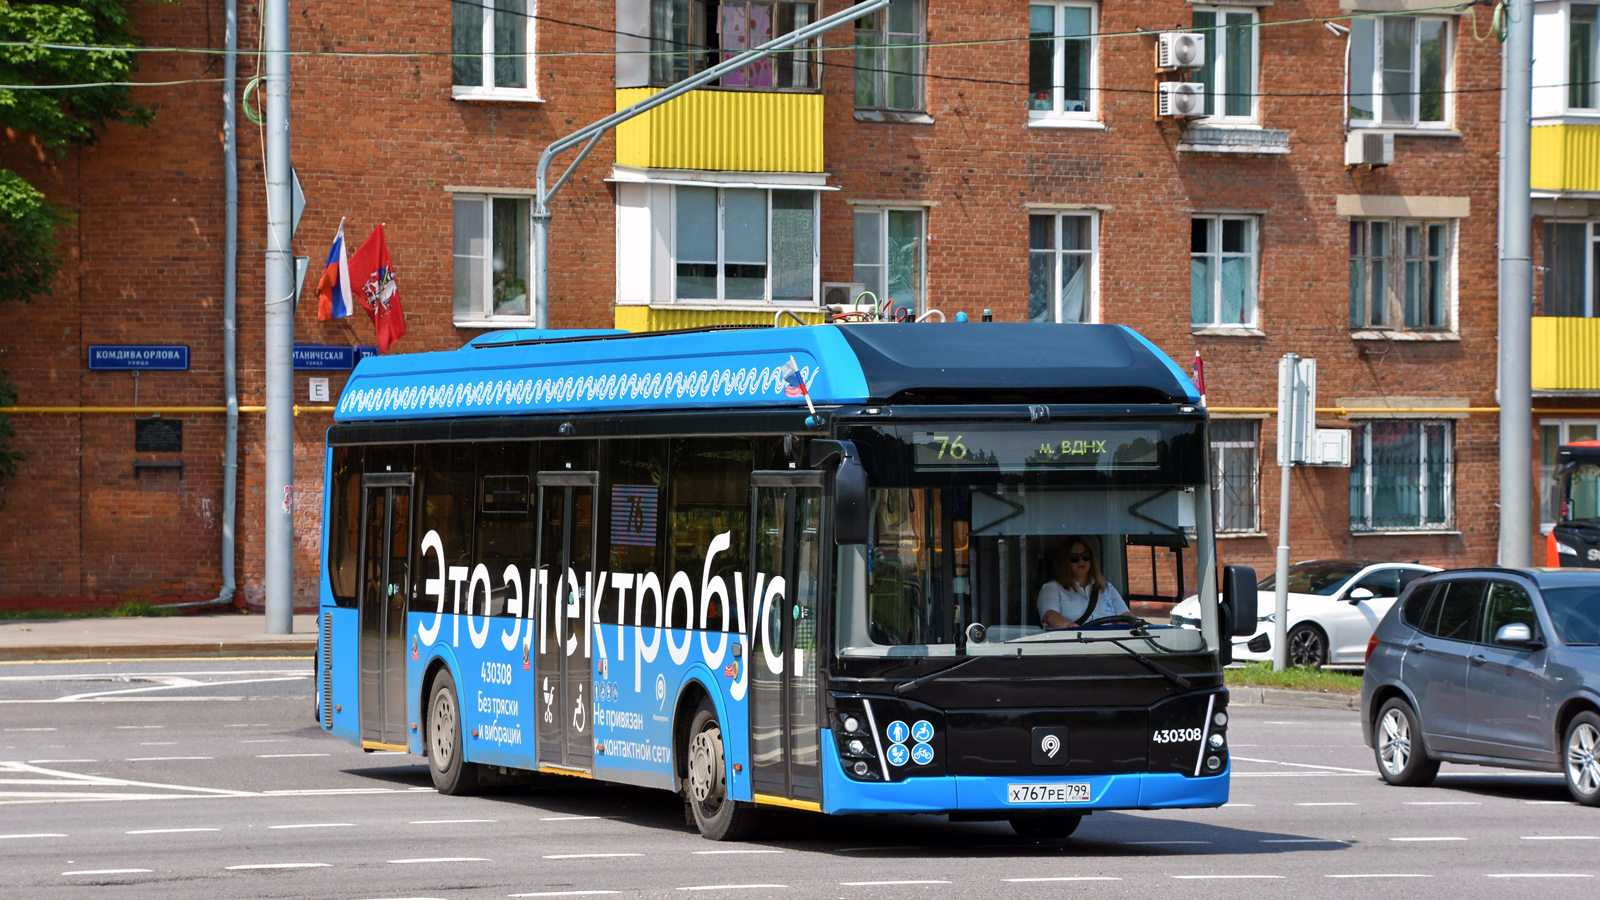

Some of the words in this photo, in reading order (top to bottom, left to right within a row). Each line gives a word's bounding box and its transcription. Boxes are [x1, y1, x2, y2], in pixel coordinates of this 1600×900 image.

[96, 350, 141, 360] КОМДИВА
[143, 350, 180, 359] ОРЛОВА
[293, 351, 343, 360] ТАНИЧЕСКАЯ
[933, 434, 967, 460] 76
[1061, 440, 1107, 455] ВДНХ
[418, 529, 491, 649] Это
[501, 530, 804, 701] электробус.
[481, 661, 512, 686] 430308
[477, 690, 492, 713] Без
[492, 697, 519, 719] тряски
[593, 701, 605, 726] Не
[606, 709, 644, 732] привязан
[478, 724, 484, 740] и
[484, 719, 522, 747] вибраций
[1152, 727, 1202, 744] 430308
[604, 738, 652, 761] контактной
[652, 745, 671, 764] сети
[1012, 786, 1065, 801] Х767РЕ
[1067, 784, 1087, 796] 799
